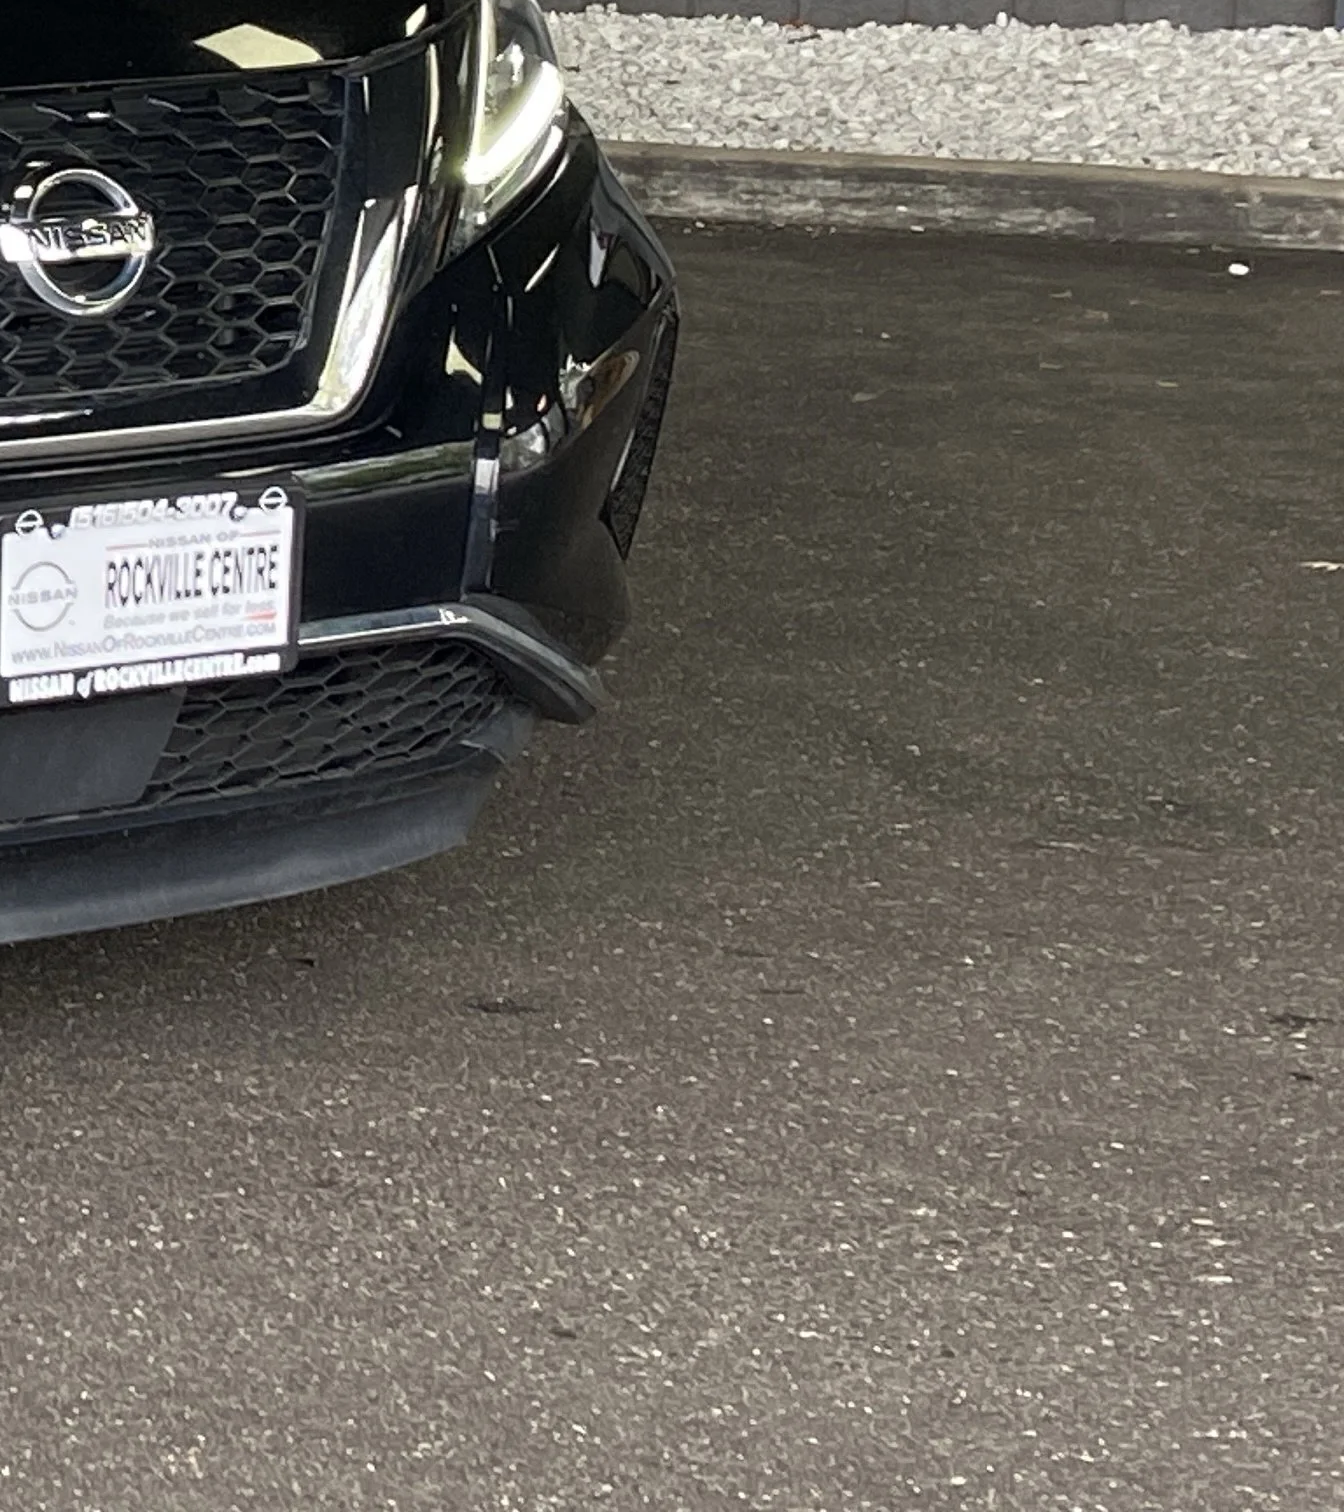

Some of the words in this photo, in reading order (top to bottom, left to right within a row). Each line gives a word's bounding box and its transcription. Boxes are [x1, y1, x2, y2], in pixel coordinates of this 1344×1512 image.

[8, 587, 78, 606] NISSAN
[103, 551, 204, 610] ROCKVILLE
[208, 543, 280, 597] CENTRE
